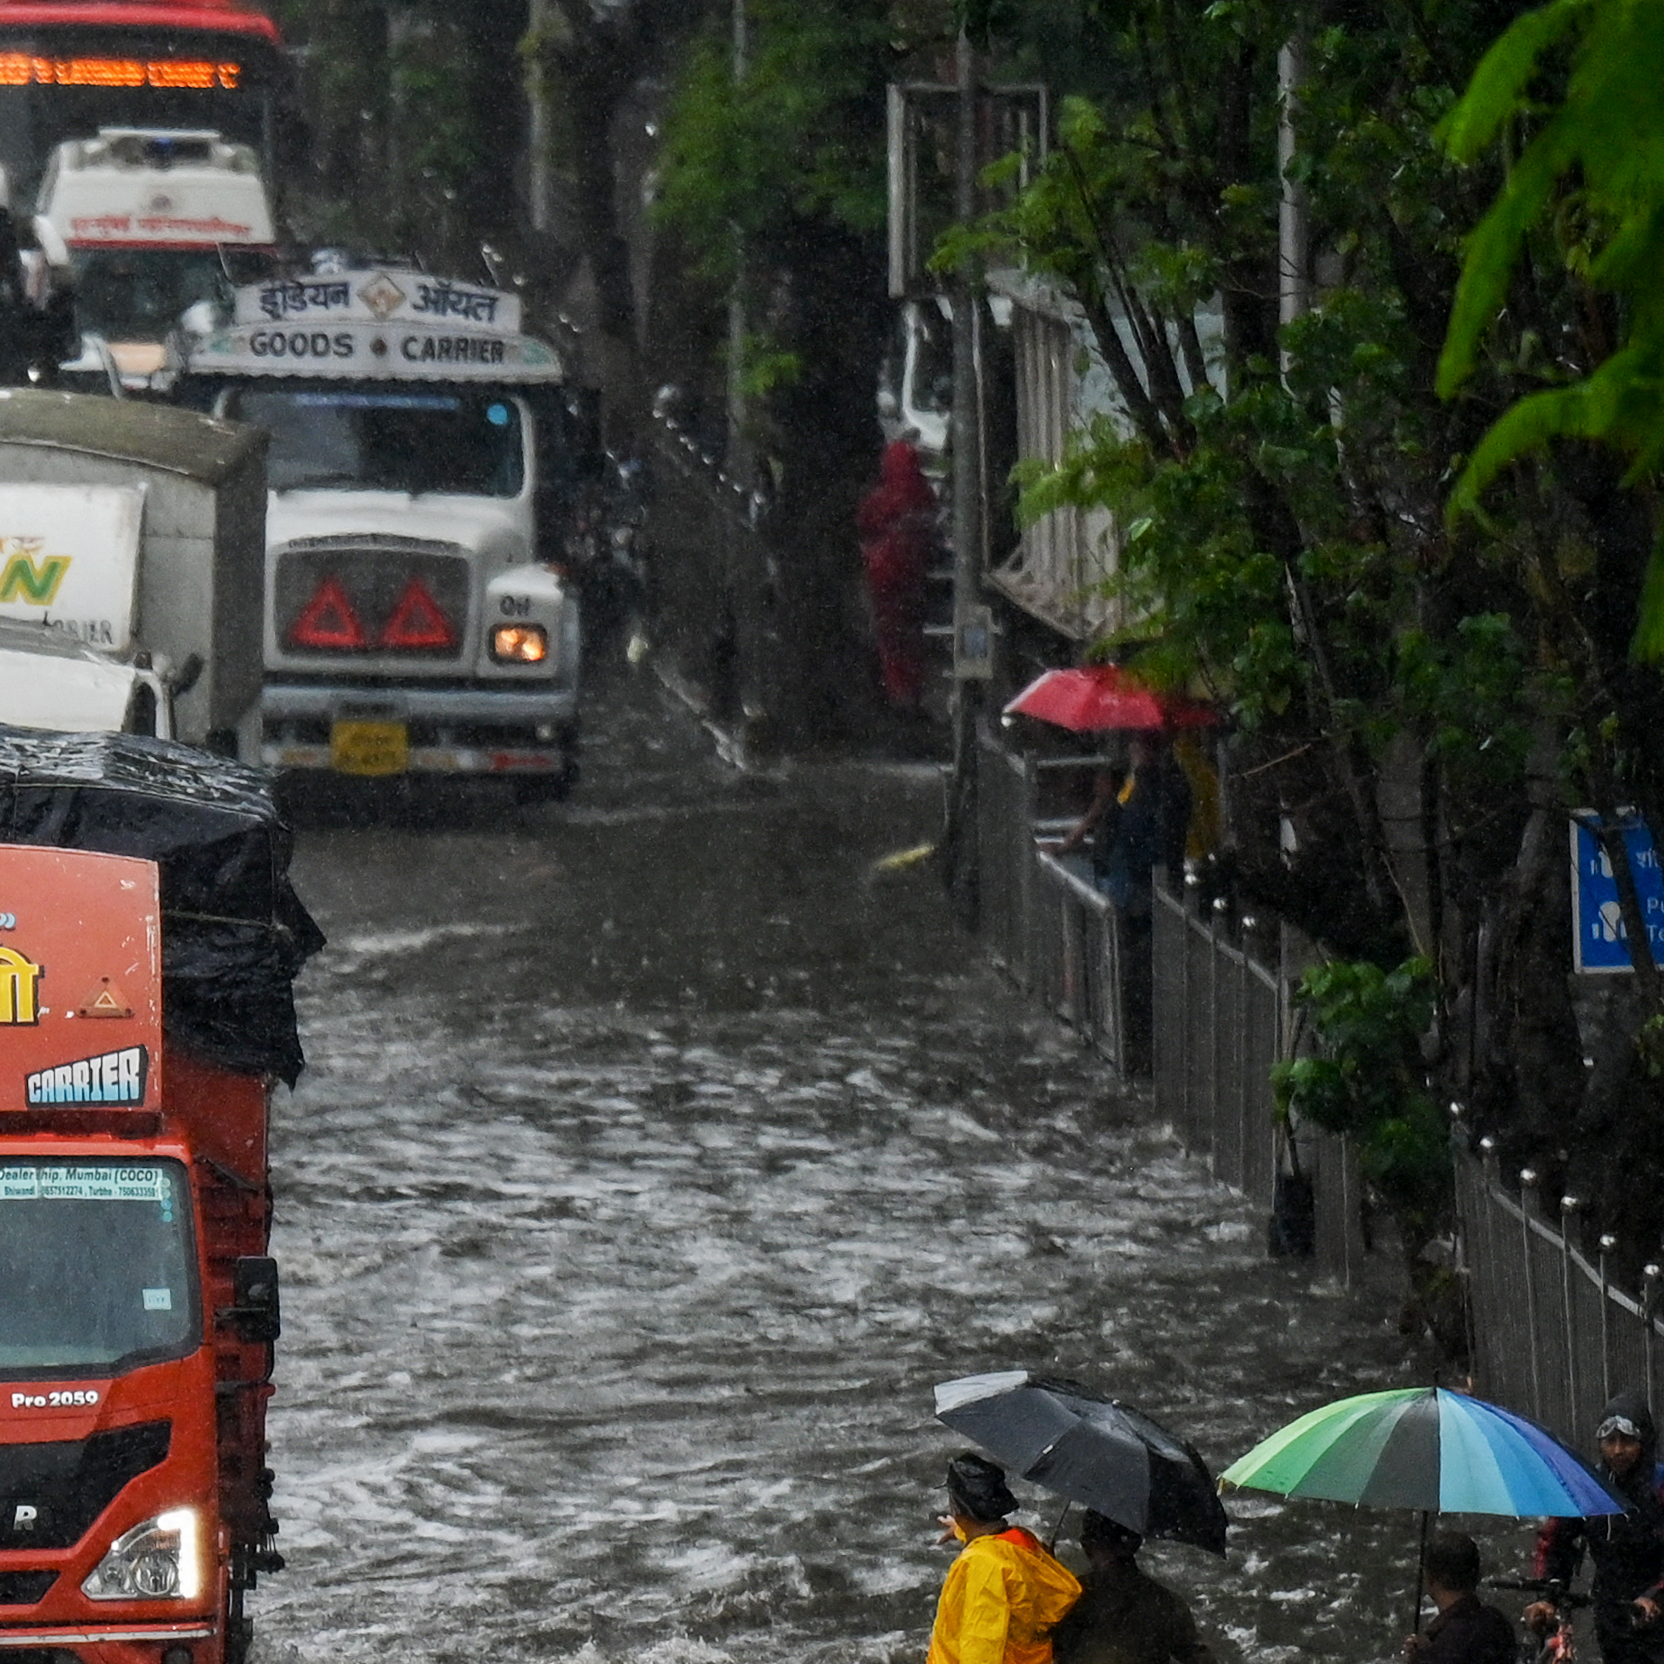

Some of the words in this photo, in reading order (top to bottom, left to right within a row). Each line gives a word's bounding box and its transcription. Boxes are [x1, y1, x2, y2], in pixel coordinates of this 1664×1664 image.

[249, 331, 354, 358] GOODS
[400, 335, 505, 364] CARRIER
[27, 1047, 141, 1104] CARRIER
[65, 1169, 112, 1181] Mumbai
[114, 1170, 159, 1182] (COCO)
[10, 1392, 47, 1409] Pro
[48, 1390, 100, 1407] 2059
